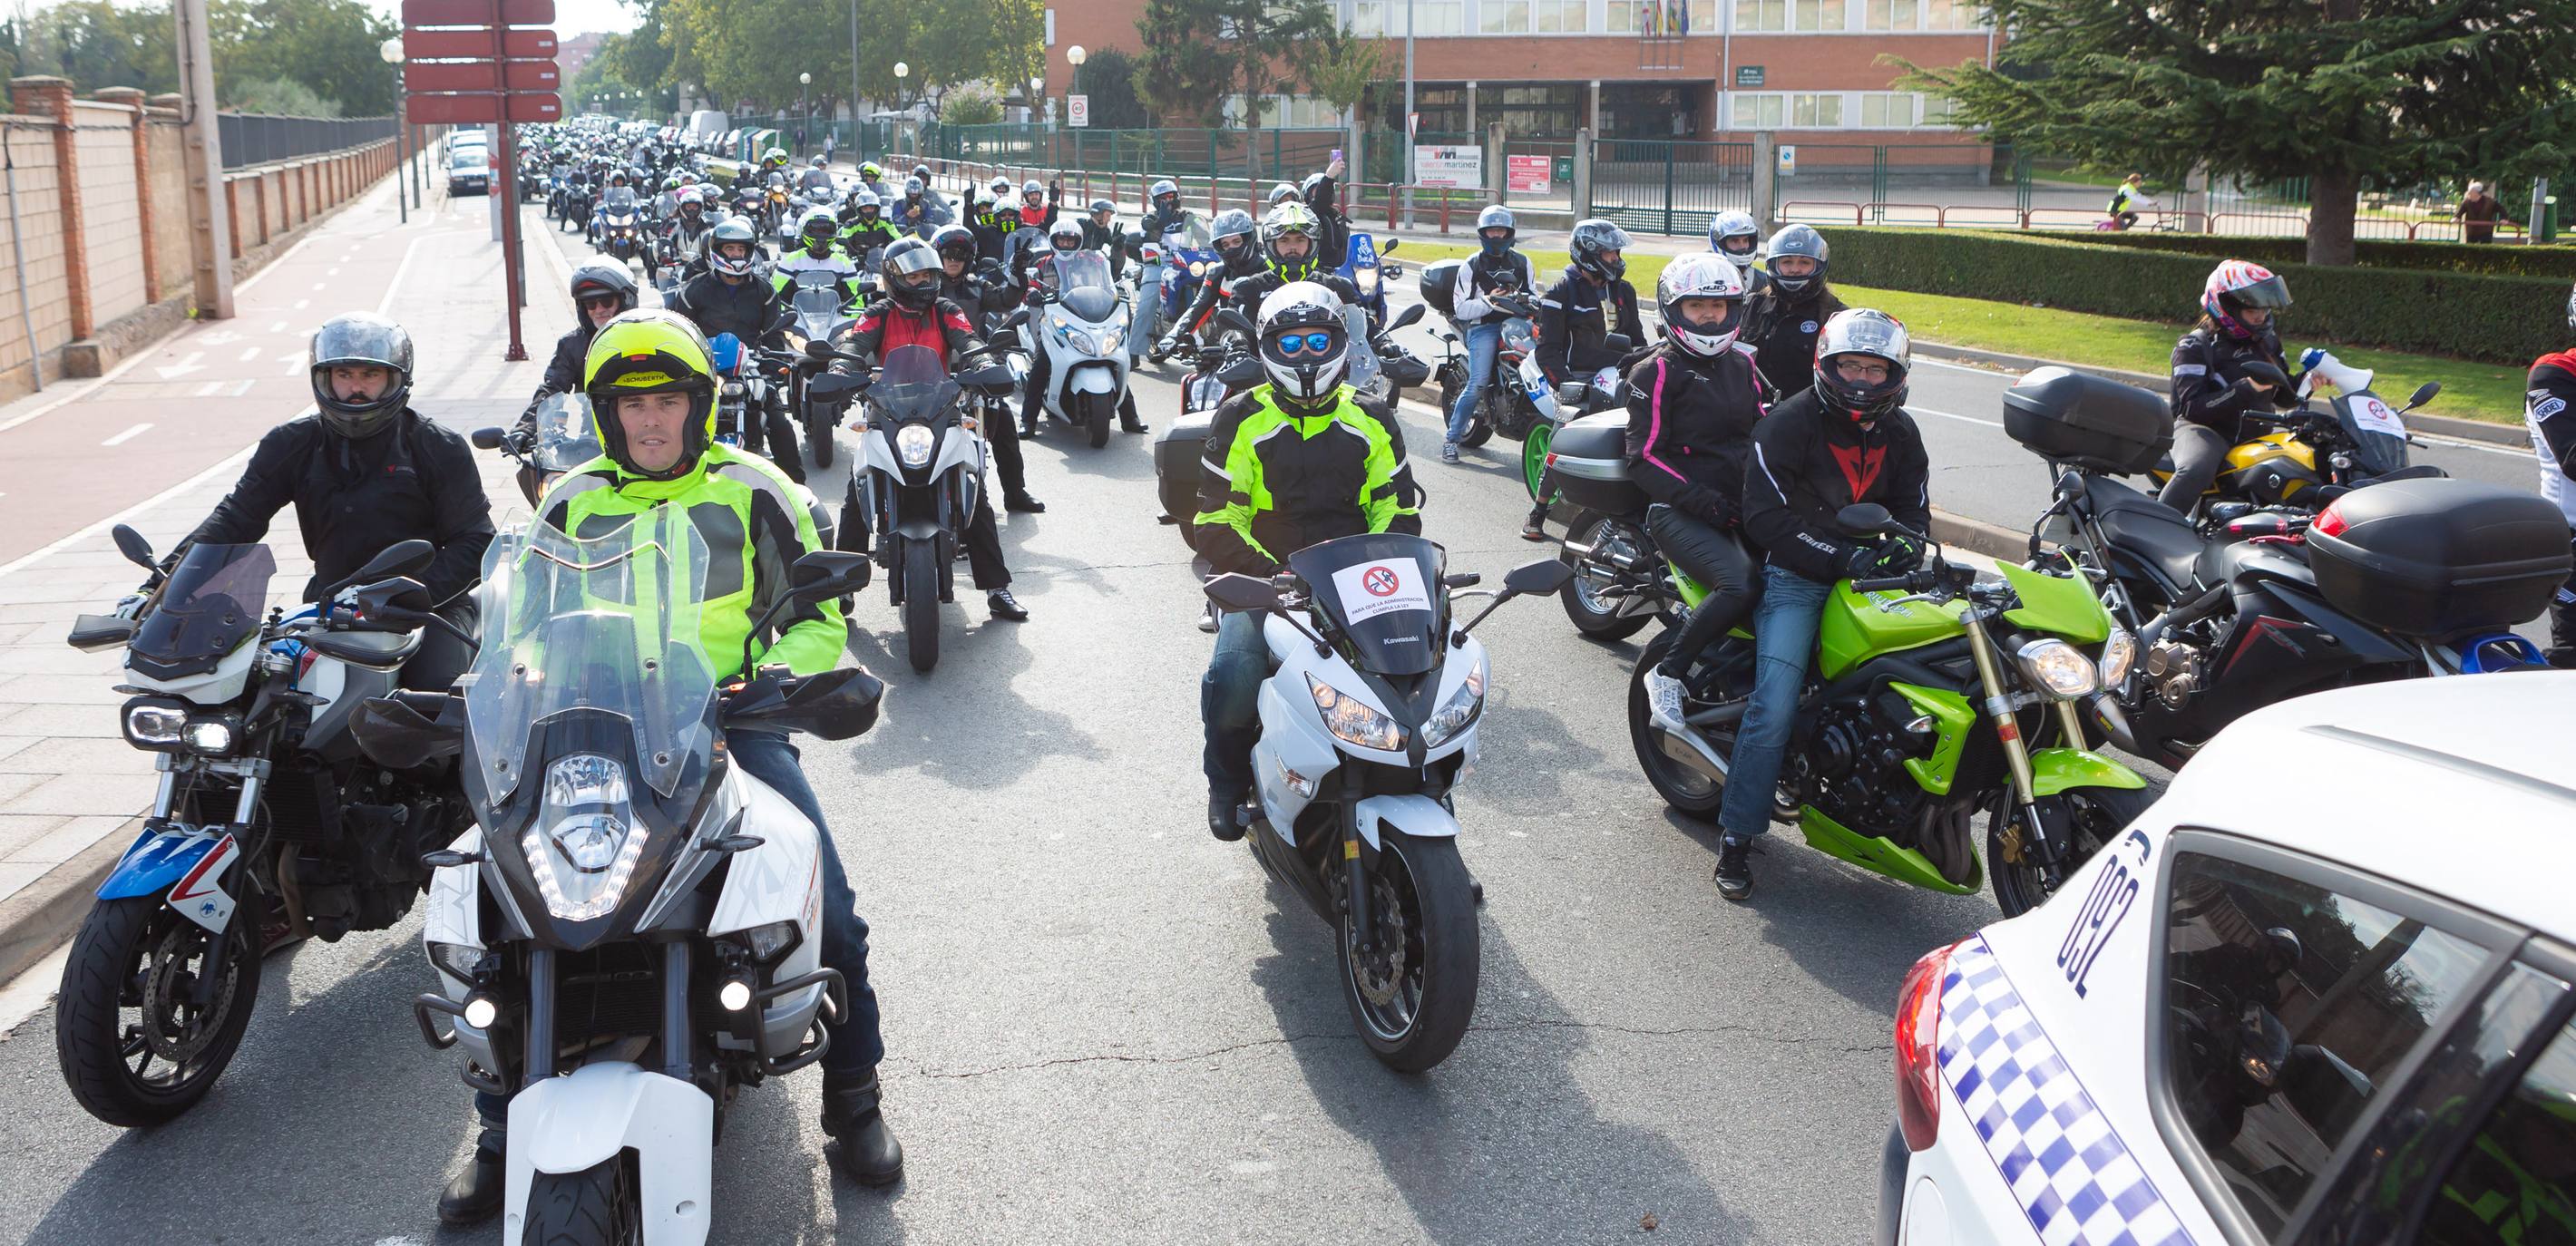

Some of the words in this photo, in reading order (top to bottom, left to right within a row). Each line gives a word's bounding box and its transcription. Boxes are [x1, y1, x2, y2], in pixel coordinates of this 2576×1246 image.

[626, 375, 664, 383] SCHUBERTH
[2537, 401, 2560, 417] SHOEI
[1797, 532, 1838, 554] DAINESE
[1351, 607, 1365, 615] PARA
[1372, 606, 1394, 614] CUMPLA
[1383, 635, 1420, 645] Kawasaki
[2057, 854, 2139, 999] 092
